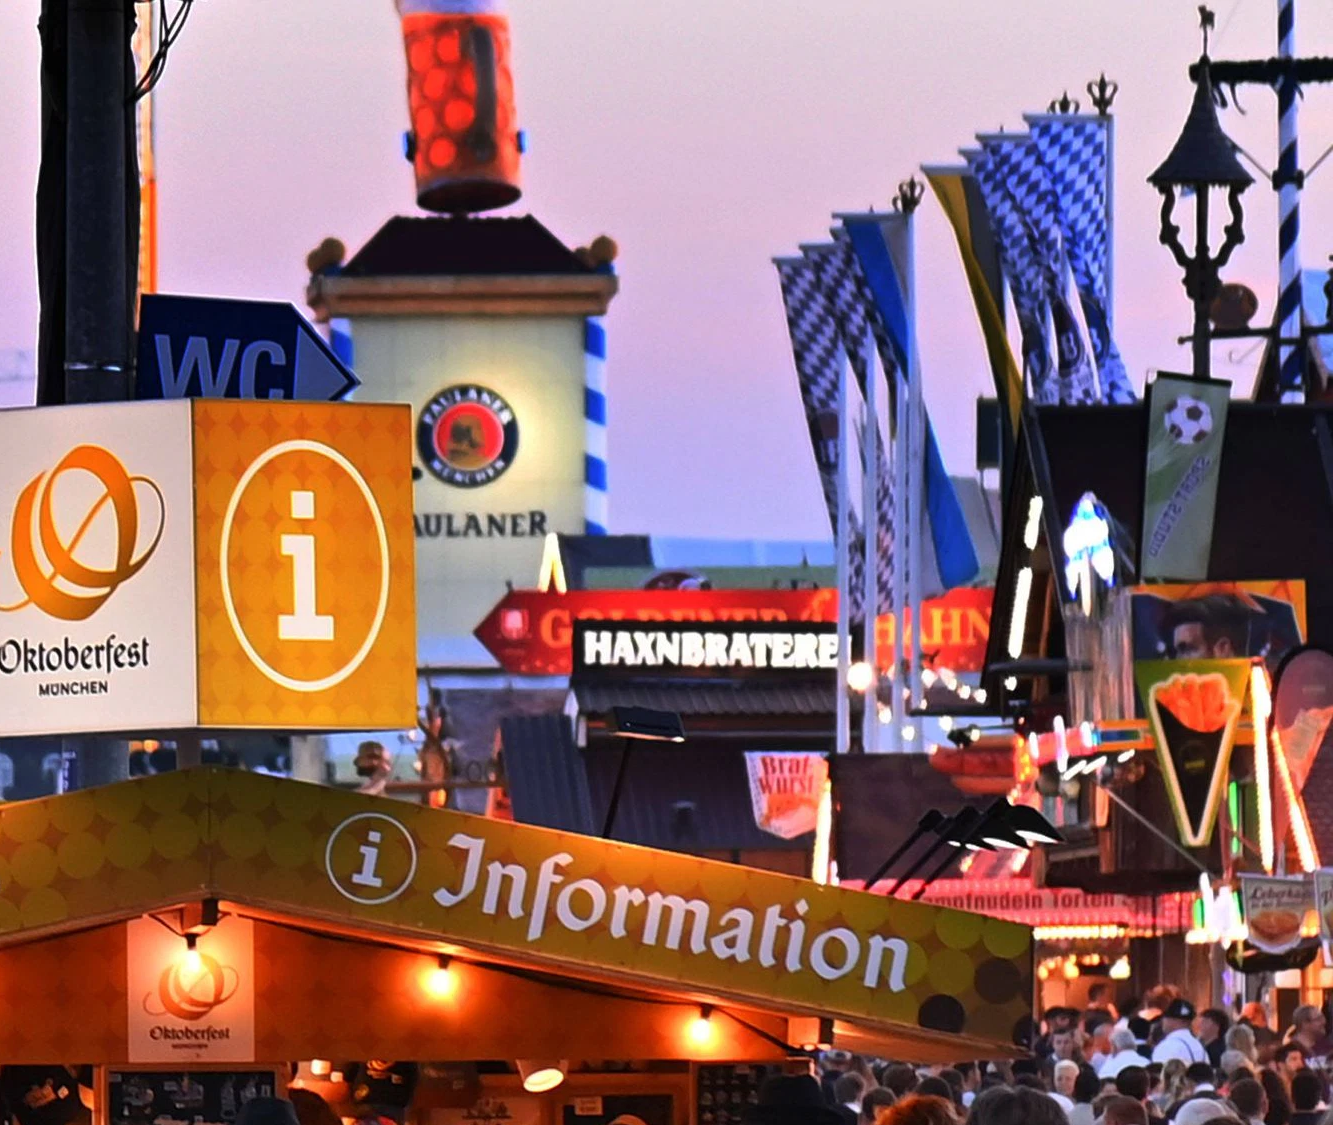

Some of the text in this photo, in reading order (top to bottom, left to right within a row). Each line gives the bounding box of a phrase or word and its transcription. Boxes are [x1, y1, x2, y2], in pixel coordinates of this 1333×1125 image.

[154, 333, 286, 398] WC
[583, 629, 853, 667] HAXNBRATEREI
[38, 680, 109, 697] MÜNCHEN
[760, 755, 810, 775] Brat
[759, 774, 815, 795] Wurst
[433, 832, 909, 993] Information
[149, 1025, 230, 1042] Oktoberfest
